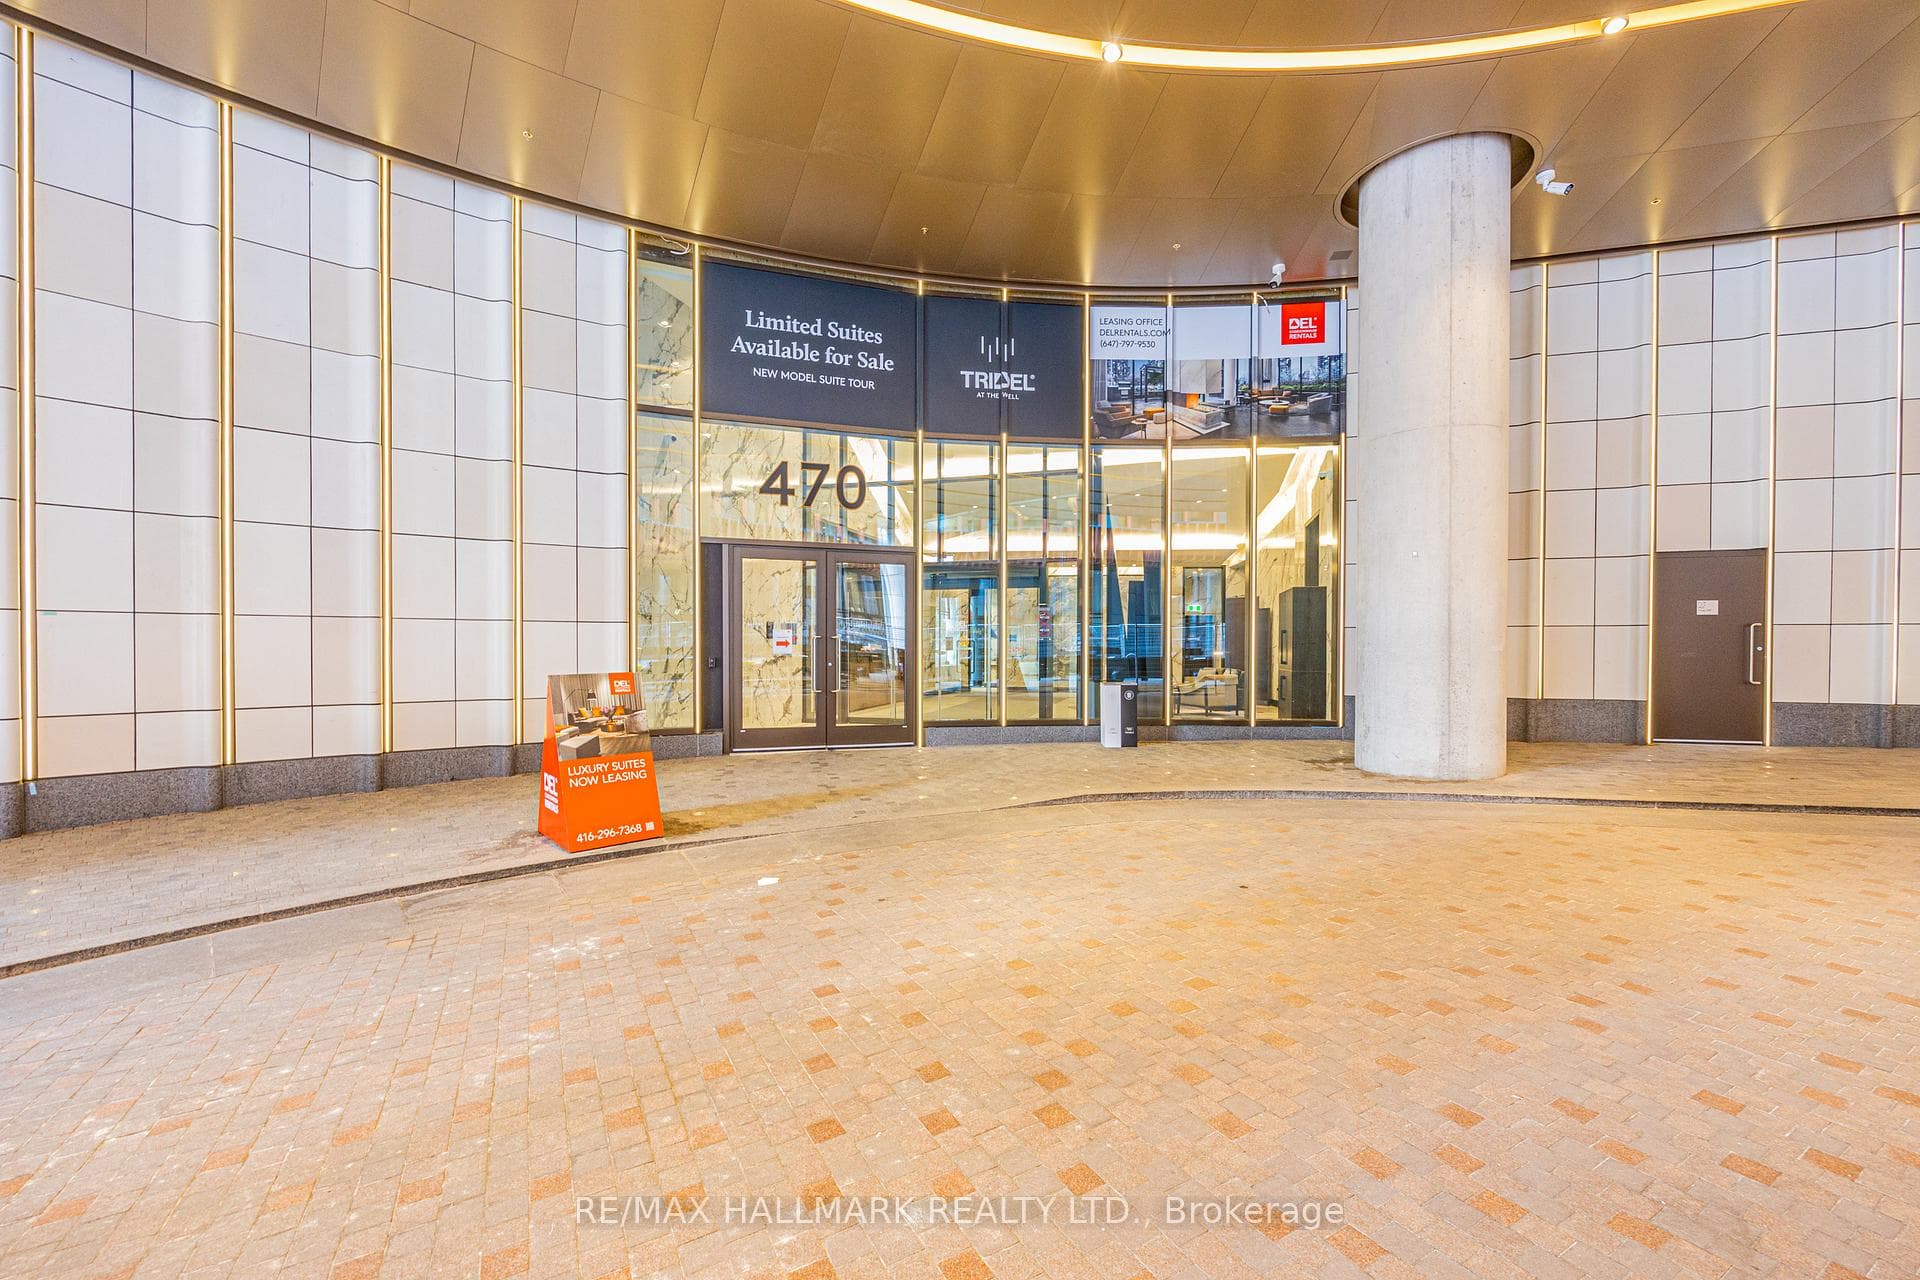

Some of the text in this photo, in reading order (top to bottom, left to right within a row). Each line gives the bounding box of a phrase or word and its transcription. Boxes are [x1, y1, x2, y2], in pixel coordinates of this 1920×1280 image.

[745, 309, 883, 344] Limited Suites
[1099, 317, 1164, 326] LEASING OFFICE
[1288, 317, 1317, 330] DEL
[1099, 328, 1171, 337] DELRENTALS.COM
[1288, 332, 1318, 340] RENTALS
[730, 335, 895, 371] Available for Sale
[1100, 339, 1156, 349] (647)-797-9530
[753, 367, 876, 390] NEW MODEL SUITE TOUR
[1001, 391, 1020, 400] WELL
[758, 461, 867, 510] 470
[567, 758, 646, 777] LUXURY SUITES
[569, 769, 647, 788] NOW LEASING
[576, 823, 643, 843] 416-296-7368
